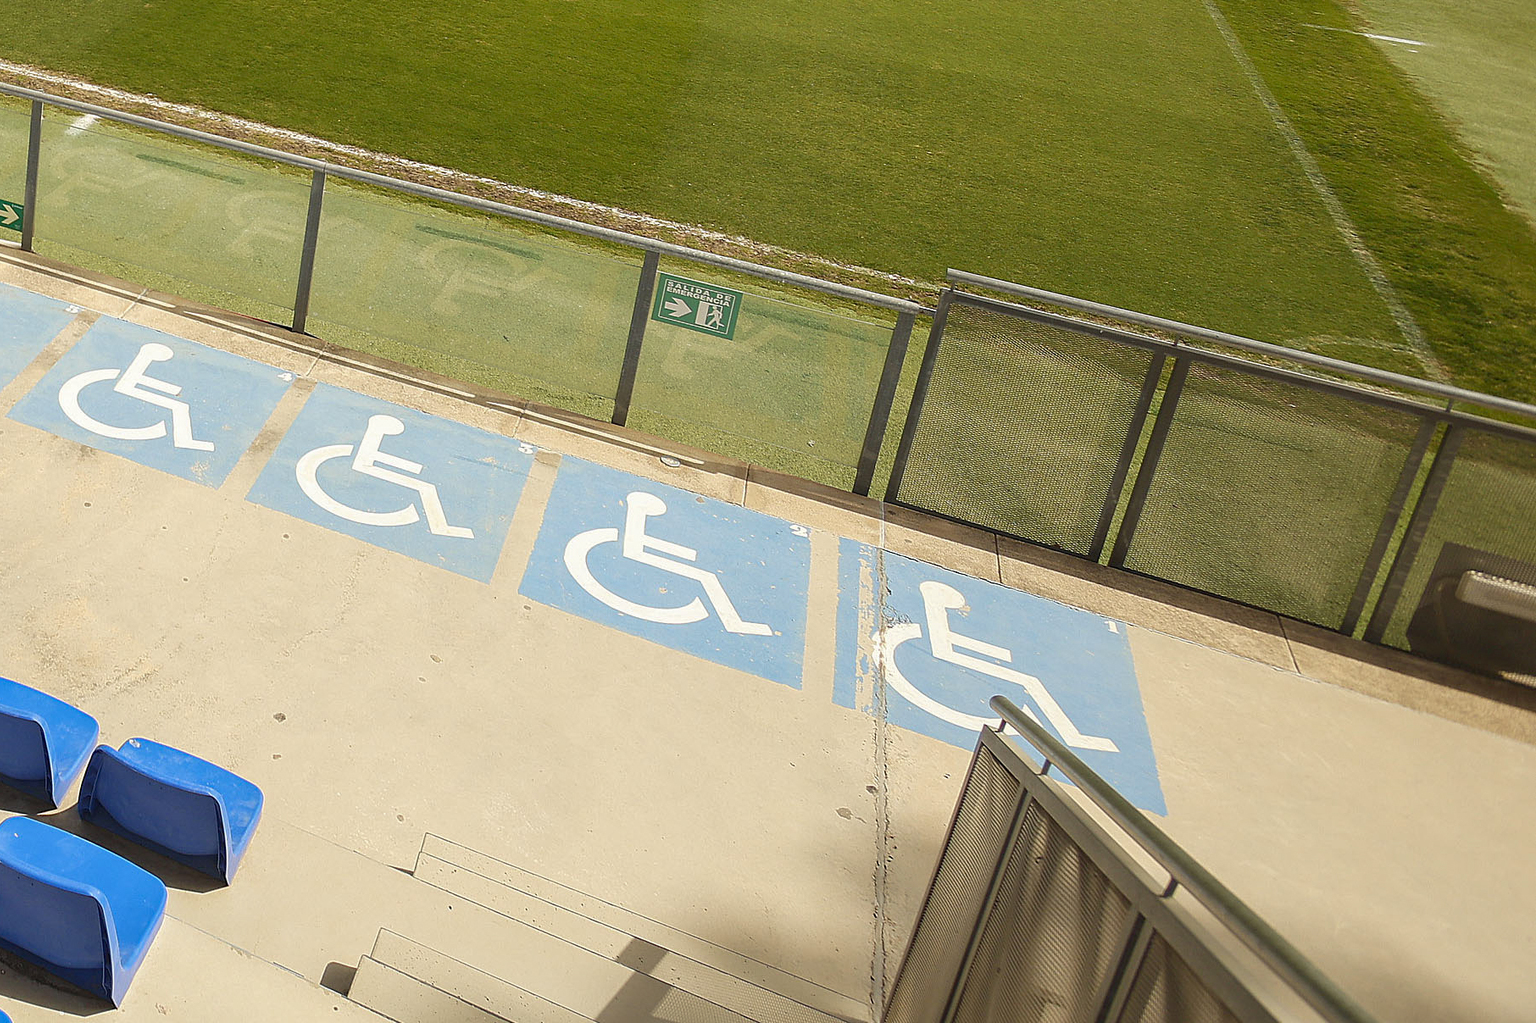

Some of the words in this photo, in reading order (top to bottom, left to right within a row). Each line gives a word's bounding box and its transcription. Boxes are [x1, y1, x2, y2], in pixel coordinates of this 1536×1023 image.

[667, 281, 710, 296] SALIDA
[716, 293, 731, 302] DE
[667, 286, 731, 307] EMERGENCIA
[789, 524, 809, 538] 2
[1104, 620, 1120, 634] 1
